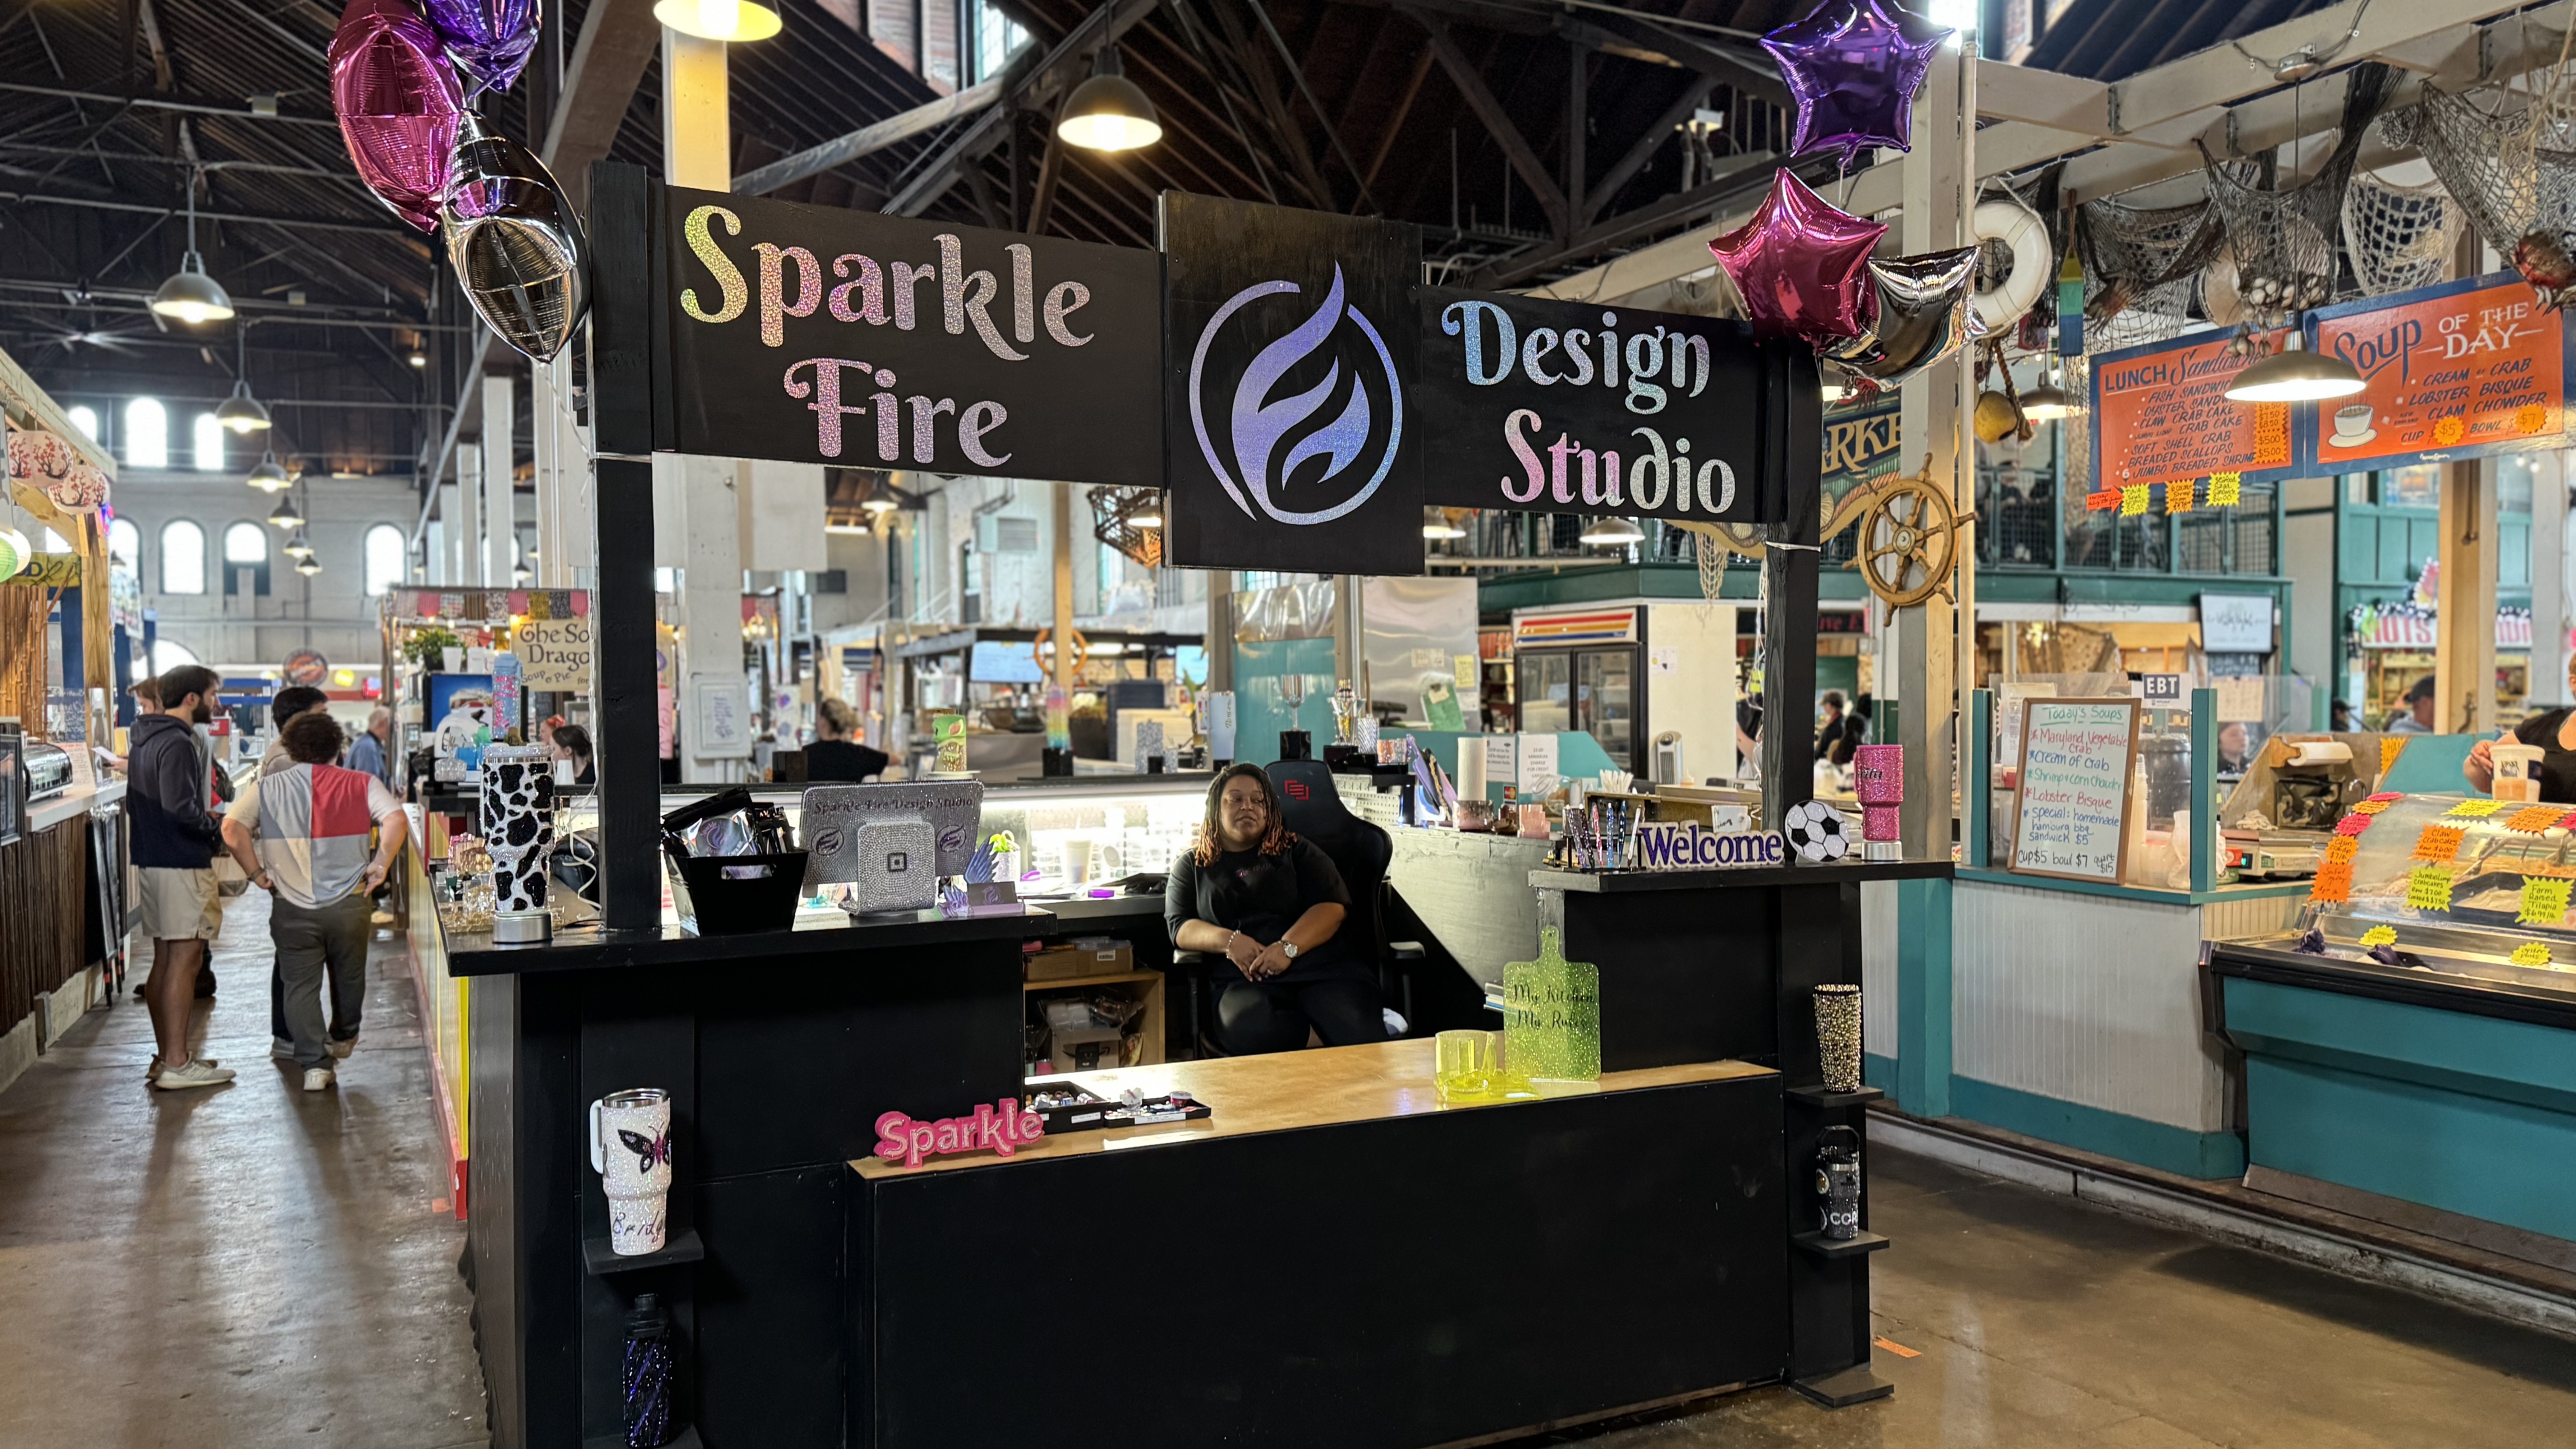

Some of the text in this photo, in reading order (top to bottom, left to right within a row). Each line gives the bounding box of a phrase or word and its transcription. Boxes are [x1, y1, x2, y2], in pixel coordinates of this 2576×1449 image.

[680, 205, 1095, 361] Sparkle
[2334, 303, 2529, 389] Soup OF THE
[2443, 323, 2519, 359] DAY
[1441, 300, 1710, 415] Design
[2106, 364, 2166, 391] LUNCH
[2423, 368, 2470, 386] CREAM
[2490, 358, 2532, 376] CRAB
[2148, 380, 2232, 404] FISH SANDWIC
[2409, 376, 2535, 406] LOBSTER BISQUE
[783, 358, 1012, 467] Fire
[2144, 401, 2185, 417] OYSTER
[2428, 391, 2547, 420] CLAM CHOWDER
[2139, 404, 2235, 429] CLAW CRAB CAKE
[2180, 420, 2209, 435] CRAB
[2213, 415, 2243, 428] CAKE
[2469, 421, 2502, 433] BOWL
[2520, 413, 2535, 426] $7
[2401, 430, 2424, 443] CUP
[2439, 423, 2456, 436] $5
[2131, 431, 2231, 455] SOFT SHELL CRAB
[1501, 408, 1736, 514] Studio
[2128, 442, 2233, 468] BREADED SCALLOPS
[2133, 464, 2167, 478] JUMBO
[2171, 457, 2218, 473] BREADED
[520, 622, 561, 643] The
[527, 644, 590, 672] Drago
[522, 670, 546, 683] Soup
[554, 672, 571, 683] Pie
[2147, 677, 2177, 694] EBT
[2042, 706, 2122, 722] Today's Soups
[2040, 728, 2128, 750] Maryland Vegetable
[2069, 755, 2082, 767] of
[2034, 768, 2063, 786] Shrimp
[2033, 786, 2113, 813] Lobster Bisque
[2032, 818, 2094, 835] hamburg bbq
[2073, 807, 2119, 826] homemade
[1639, 825, 1781, 866] Welcome
[2075, 833, 2088, 845] $5
[2034, 847, 2048, 864] $5
[2053, 852, 2073, 866] bowl
[2075, 852, 2088, 868] $7
[2093, 853, 2115, 867] quart
[2100, 862, 2113, 874] $15
[2529, 893, 2558, 902] Raised
[2532, 884, 2553, 894] Farm
[2528, 901, 2557, 911] Tilapia
[1511, 983, 1541, 1005] My
[1513, 1009, 1541, 1030] My
[882, 1103, 1043, 1165] Sparkle
